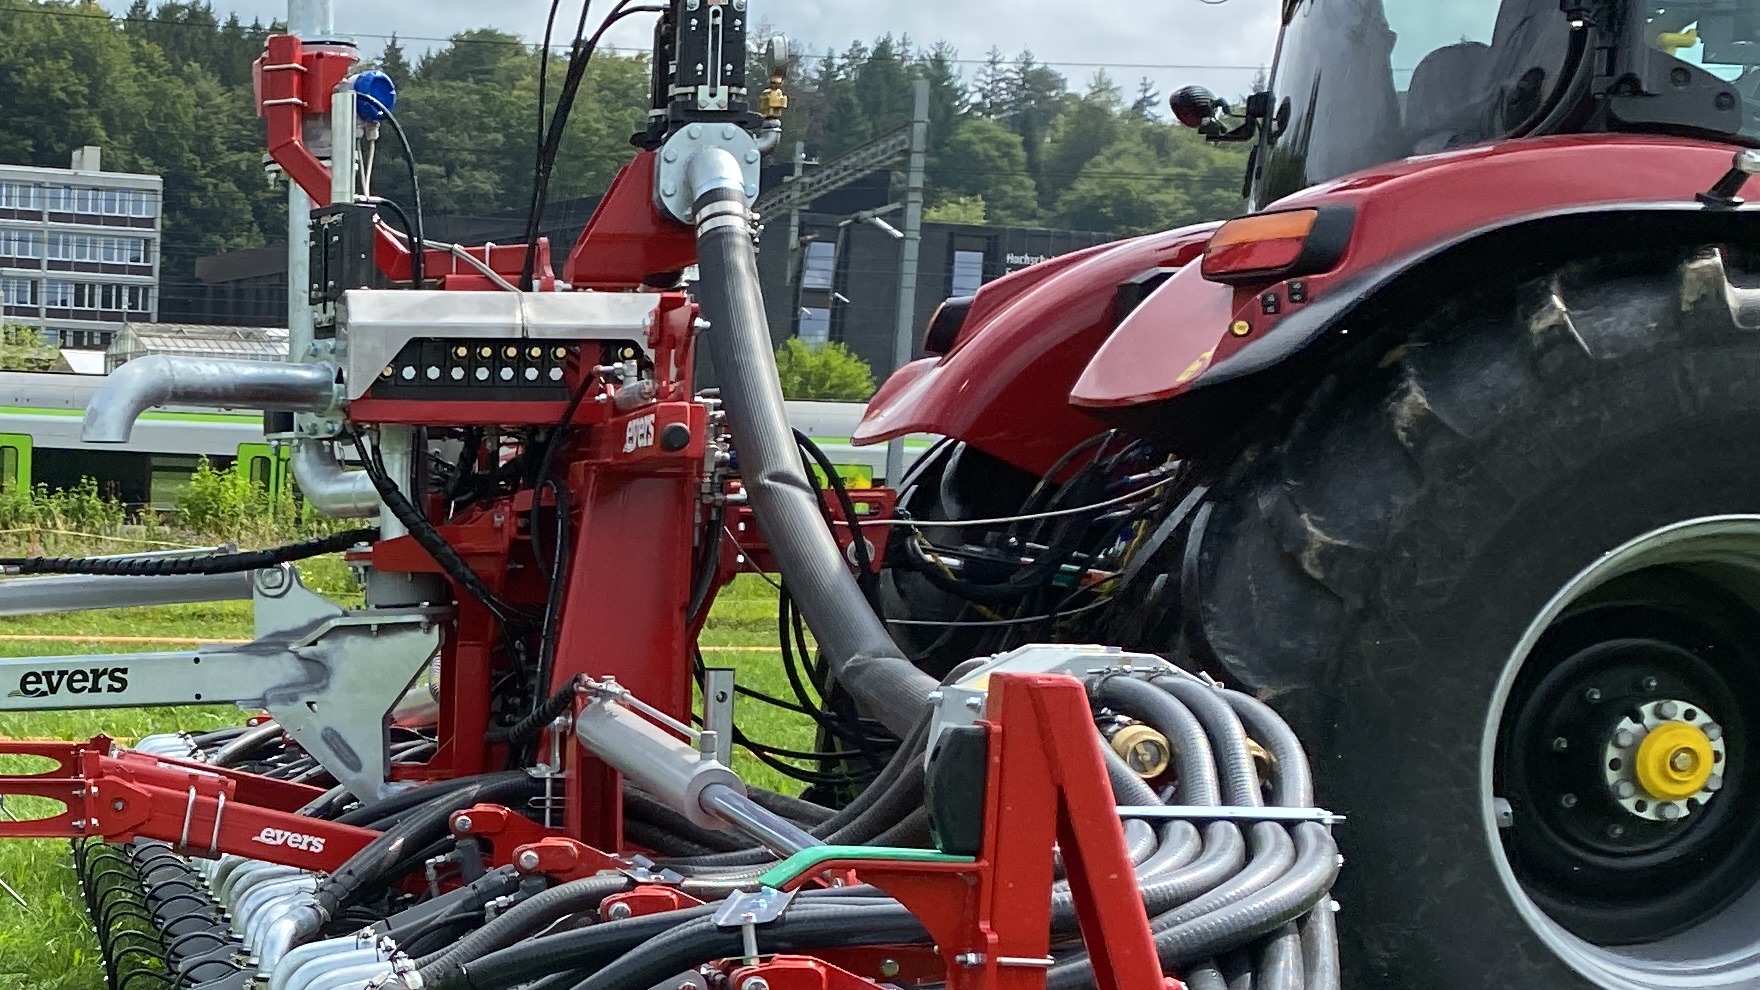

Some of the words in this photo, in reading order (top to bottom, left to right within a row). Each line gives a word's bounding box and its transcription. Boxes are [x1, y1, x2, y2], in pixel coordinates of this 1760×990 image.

[625, 413, 656, 451] evers
[19, 667, 129, 696] evers
[259, 827, 326, 854] evers
